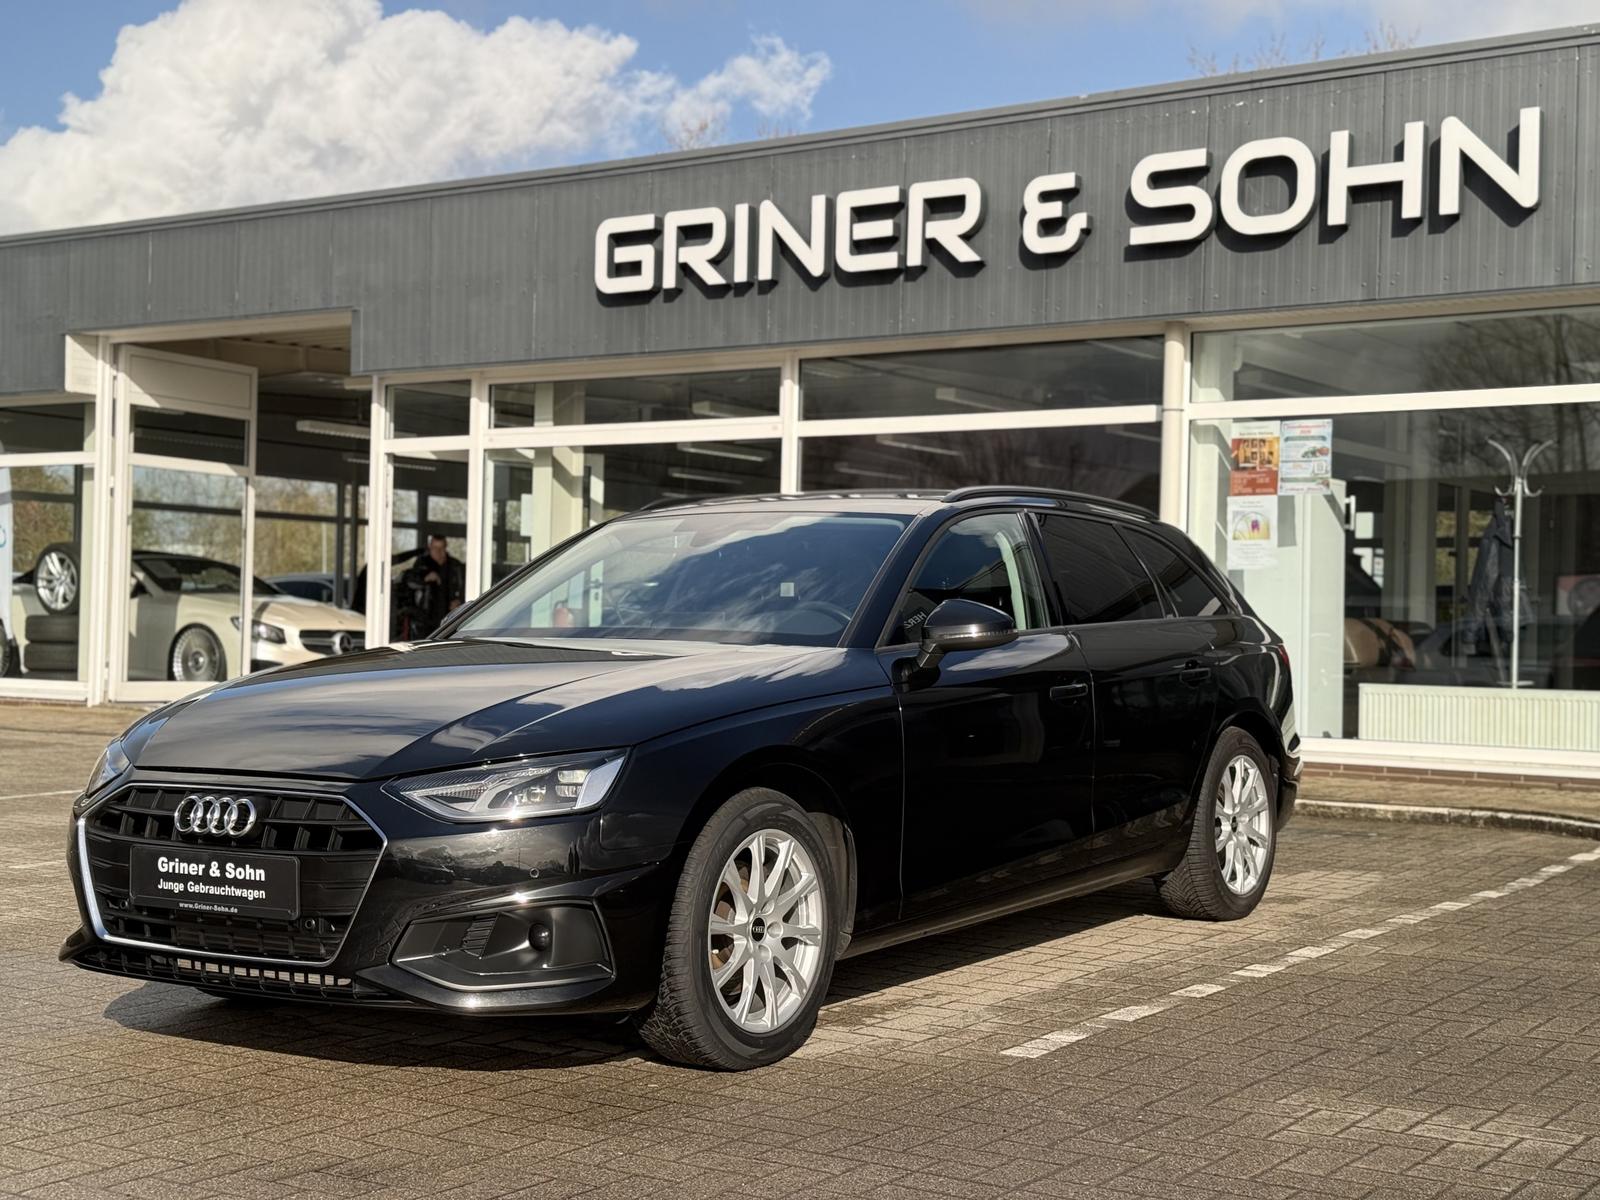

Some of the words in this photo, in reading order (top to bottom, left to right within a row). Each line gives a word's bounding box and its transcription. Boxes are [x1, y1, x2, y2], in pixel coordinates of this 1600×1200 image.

[594, 177, 985, 296] GRINER
[1022, 172, 1090, 255] &
[1129, 106, 1541, 246] SOHN
[157, 856, 205, 876] Griner
[209, 861, 221, 878] &
[225, 862, 266, 881] Sohn
[157, 878, 185, 893] Junge
[187, 881, 266, 900] Gebrauchtwagen
[179, 902, 238, 914] www.Griner-Sohn.de
